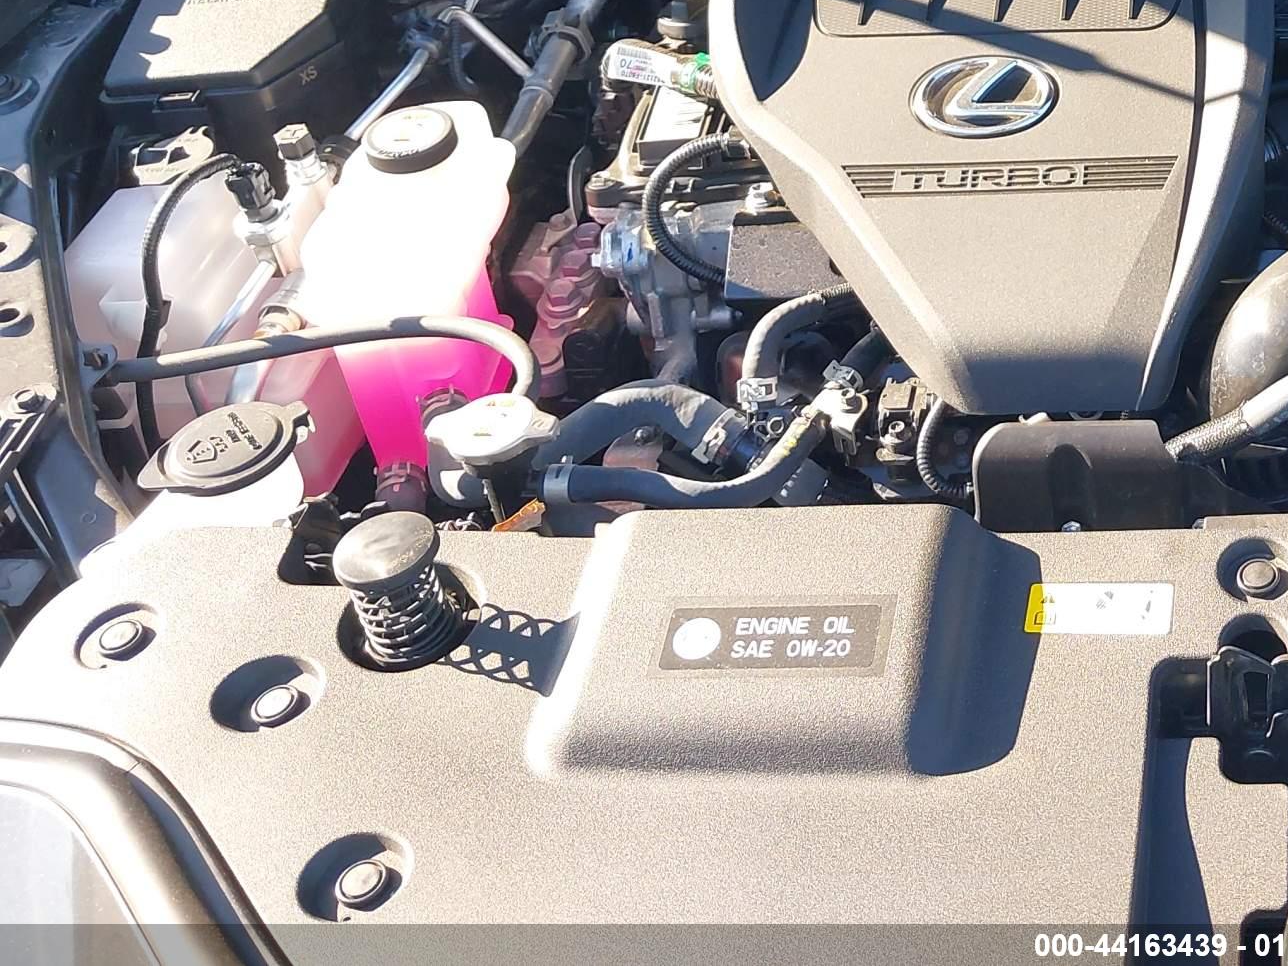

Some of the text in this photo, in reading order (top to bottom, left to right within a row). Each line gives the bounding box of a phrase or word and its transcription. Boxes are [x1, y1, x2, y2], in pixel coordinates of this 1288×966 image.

[300, 65, 318, 85] XS
[900, 165, 1079, 190] TURBO
[735, 616, 855, 635] ENGINE OIL
[730, 639, 850, 658] SAE 0W-20
